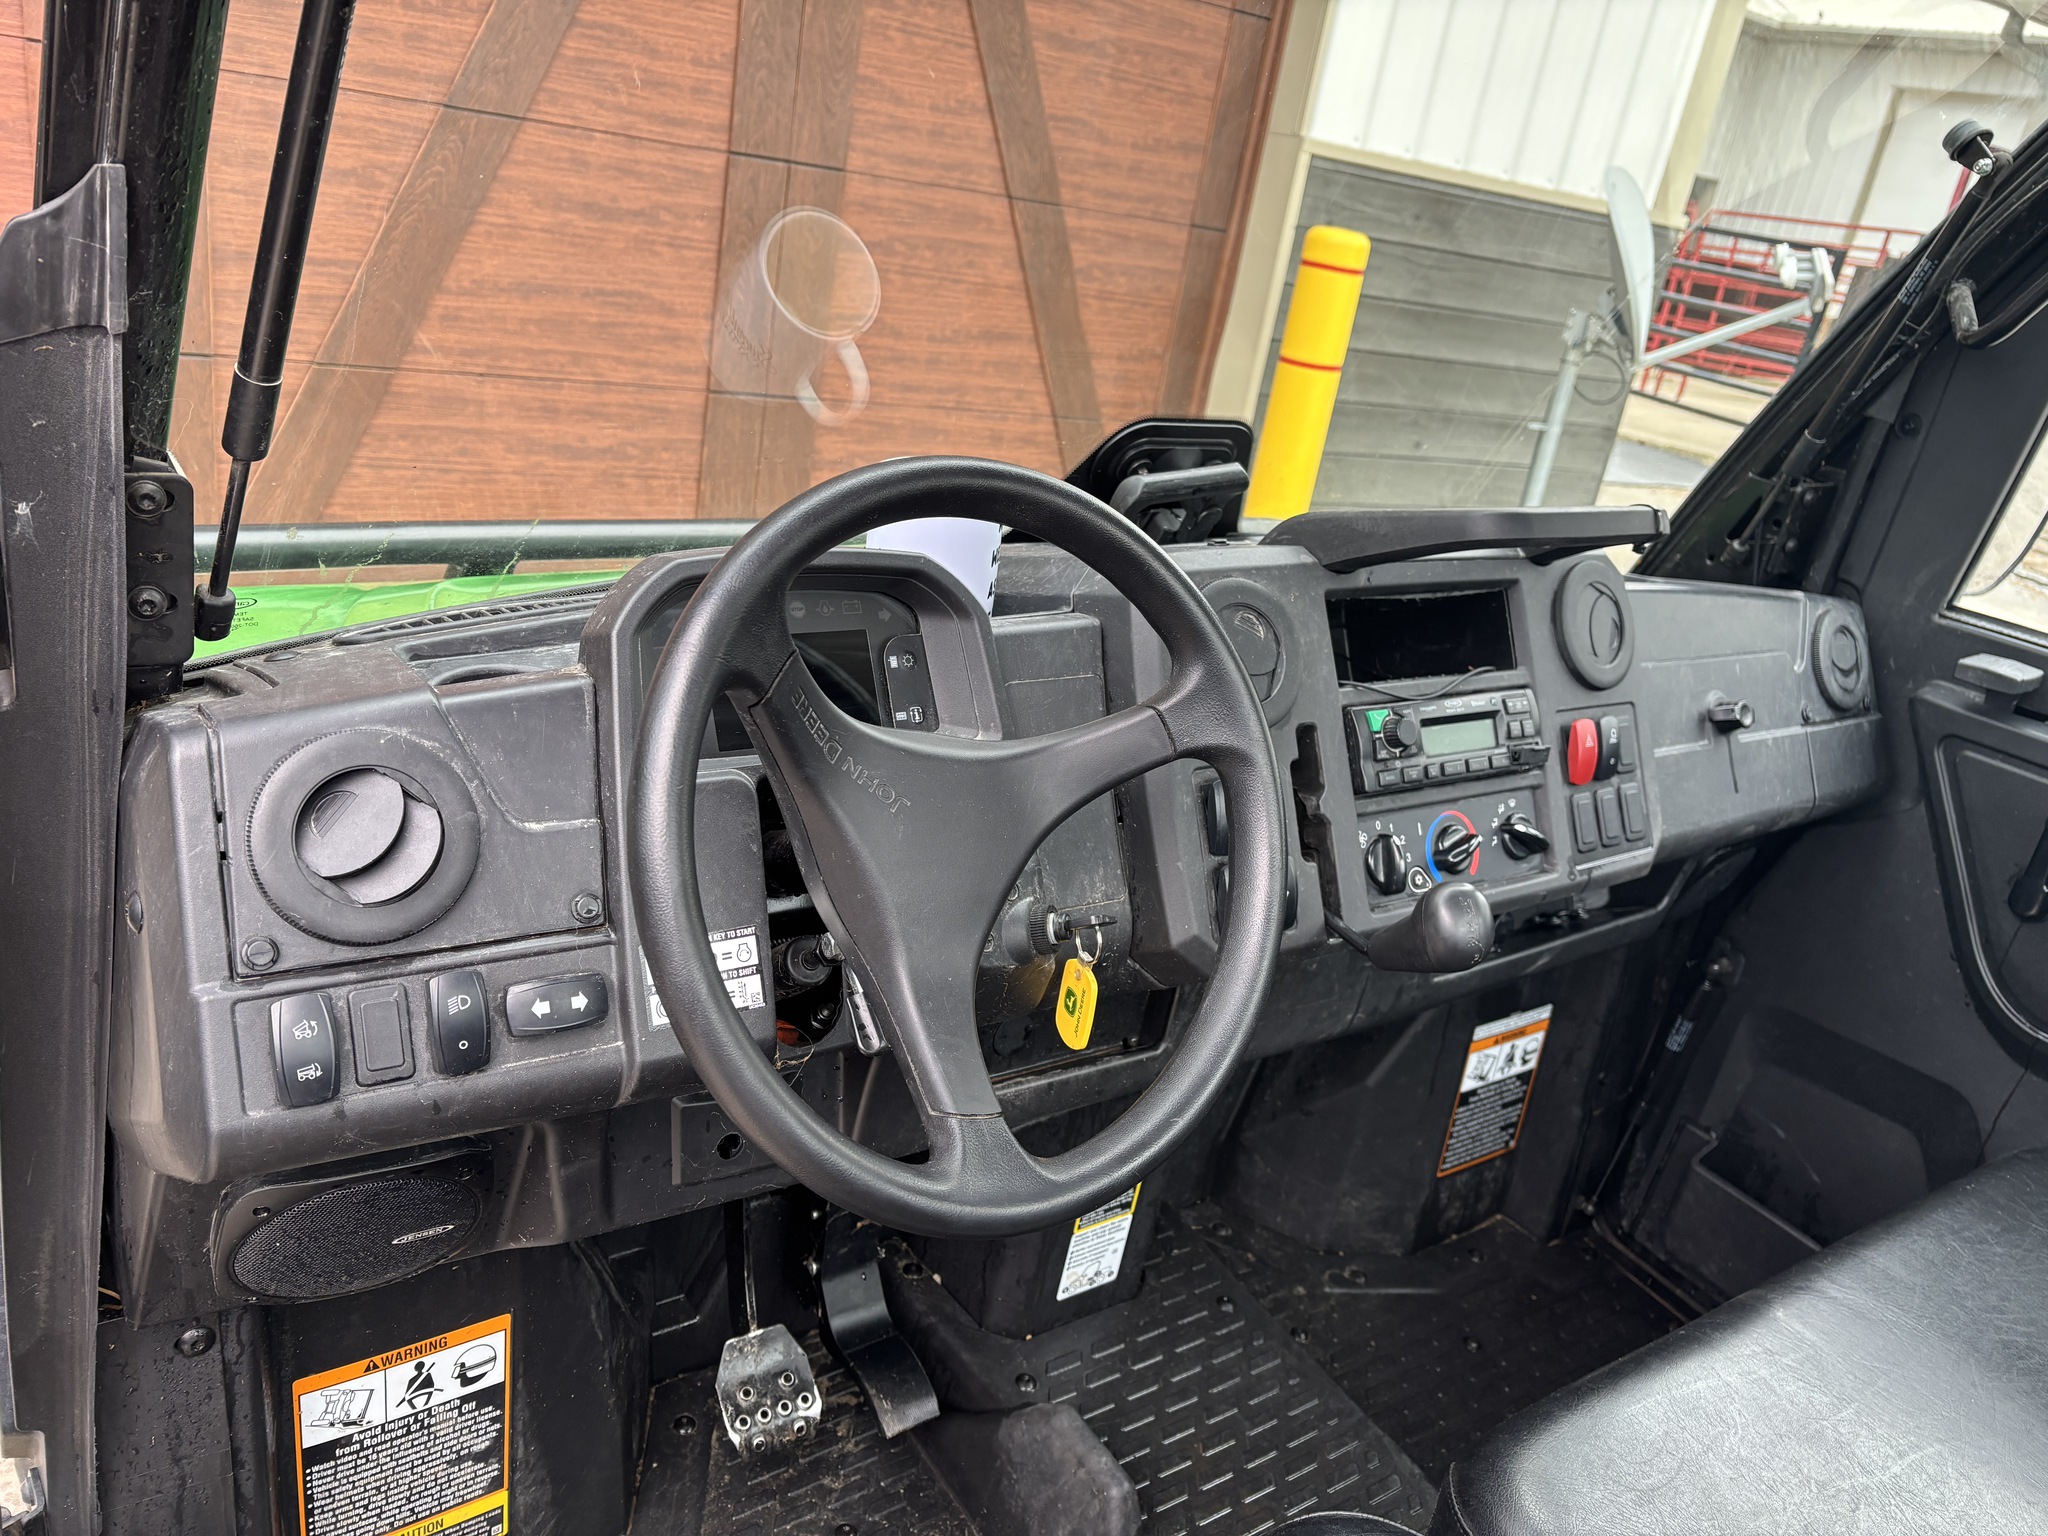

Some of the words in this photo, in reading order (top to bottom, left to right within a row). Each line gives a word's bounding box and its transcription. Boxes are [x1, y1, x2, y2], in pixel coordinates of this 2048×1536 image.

[791, 687, 843, 765] DEERE
[842, 756, 912, 813] JOHN
[1375, 820, 1381, 830] 0
[1389, 823, 1393, 832] 1
[1400, 835, 1406, 844] 2
[1406, 853, 1411, 862] 3
[713, 932, 726, 940] KEY
[727, 930, 735, 938] TO
[736, 926, 756, 936] START
[729, 969, 738, 978] TO
[739, 966, 757, 976] SHIFT
[1078, 987, 1086, 1015] DEERE
[380, 1336, 448, 1367] WARNING
[335, 1441, 359, 1457] from
[363, 1425, 406, 1448] Rollover
[410, 1421, 420, 1431] or
[423, 1407, 458, 1428] Falling
[461, 1400, 475, 1413] Off
[352, 1425, 381, 1443] Avoid
[384, 1413, 414, 1433] Injury
[417, 1410, 428, 1420] or
[431, 1397, 460, 1415] Death
[311, 1459, 335, 1473] Watch
[336, 1452, 357, 1464] video
[359, 1447, 372, 1457] and
[374, 1441, 390, 1452] read
[392, 1428, 427, 1447] operator's
[457, 1410, 478, 1422] before
[312, 1467, 335, 1479] Driver
[336, 1459, 355, 1471] must
[378, 1446, 398, 1458] years
[400, 1440, 411, 1449] old
[412, 1434, 428, 1445] with
[454, 1419, 474, 1430] driver
[312, 1475, 334, 1487] Never
[336, 1468, 354, 1479] drive
[356, 1460, 377, 1472] under
[379, 1455, 390, 1464] the
[392, 1443, 424, 1459] influence
[435, 1430, 460, 1444] alcohol
[312, 1480, 339, 1494] Vehicle
[348, 1465, 380, 1483] equipped
[382, 1459, 396, 1470] with
[398, 1449, 428, 1464] seatbelts
[429, 1443, 441, 1453] and
[443, 1438, 457, 1448] side
[459, 1431, 477, 1442] doors
[313, 1490, 329, 1500] This
[330, 1482, 352, 1495] safety
[354, 1468, 392, 1488] equipment
[394, 1461, 411, 1473] must
[423, 1451, 440, 1462] used
[451, 1443, 460, 1452] all
[398, 1472, 420, 1486] higher
[313, 1496, 333, 1507] Wear
[335, 1485, 364, 1500] helmets
[365, 1478, 384, 1489] when
[386, 1469, 411, 1483] driving
[314, 1511, 332, 1522] Keep
[335, 1504, 353, 1514] arms
[354, 1497, 368, 1507] and
[370, 1492, 385, 1502] legs
[387, 1484, 408, 1496] inside
[410, 1474, 434, 1487] vehicle
[436, 1465, 458, 1478] during
[315, 1516, 336, 1528] While
[367, 1499, 386, 1509] drive
[387, 1490, 410, 1503] slowly
[411, 1484, 424, 1494] and
[436, 1475, 447, 1484] not
[381, 1507, 399, 1518] while
[401, 1495, 431, 1512] operating
[441, 1484, 457, 1496] night
[315, 1523, 334, 1535] Drive
[336, 1515, 359, 1528] slowly
[361, 1507, 380, 1519] when
[355, 1523, 374, 1535] going
[376, 1516, 394, 1527] down
[414, 1499, 438, 1513] Vehicle
[439, 1493, 453, 1503] may
[404, 1513, 415, 1523] not
[417, 1509, 430, 1518] use
[441, 1496, 462, 1510] public
